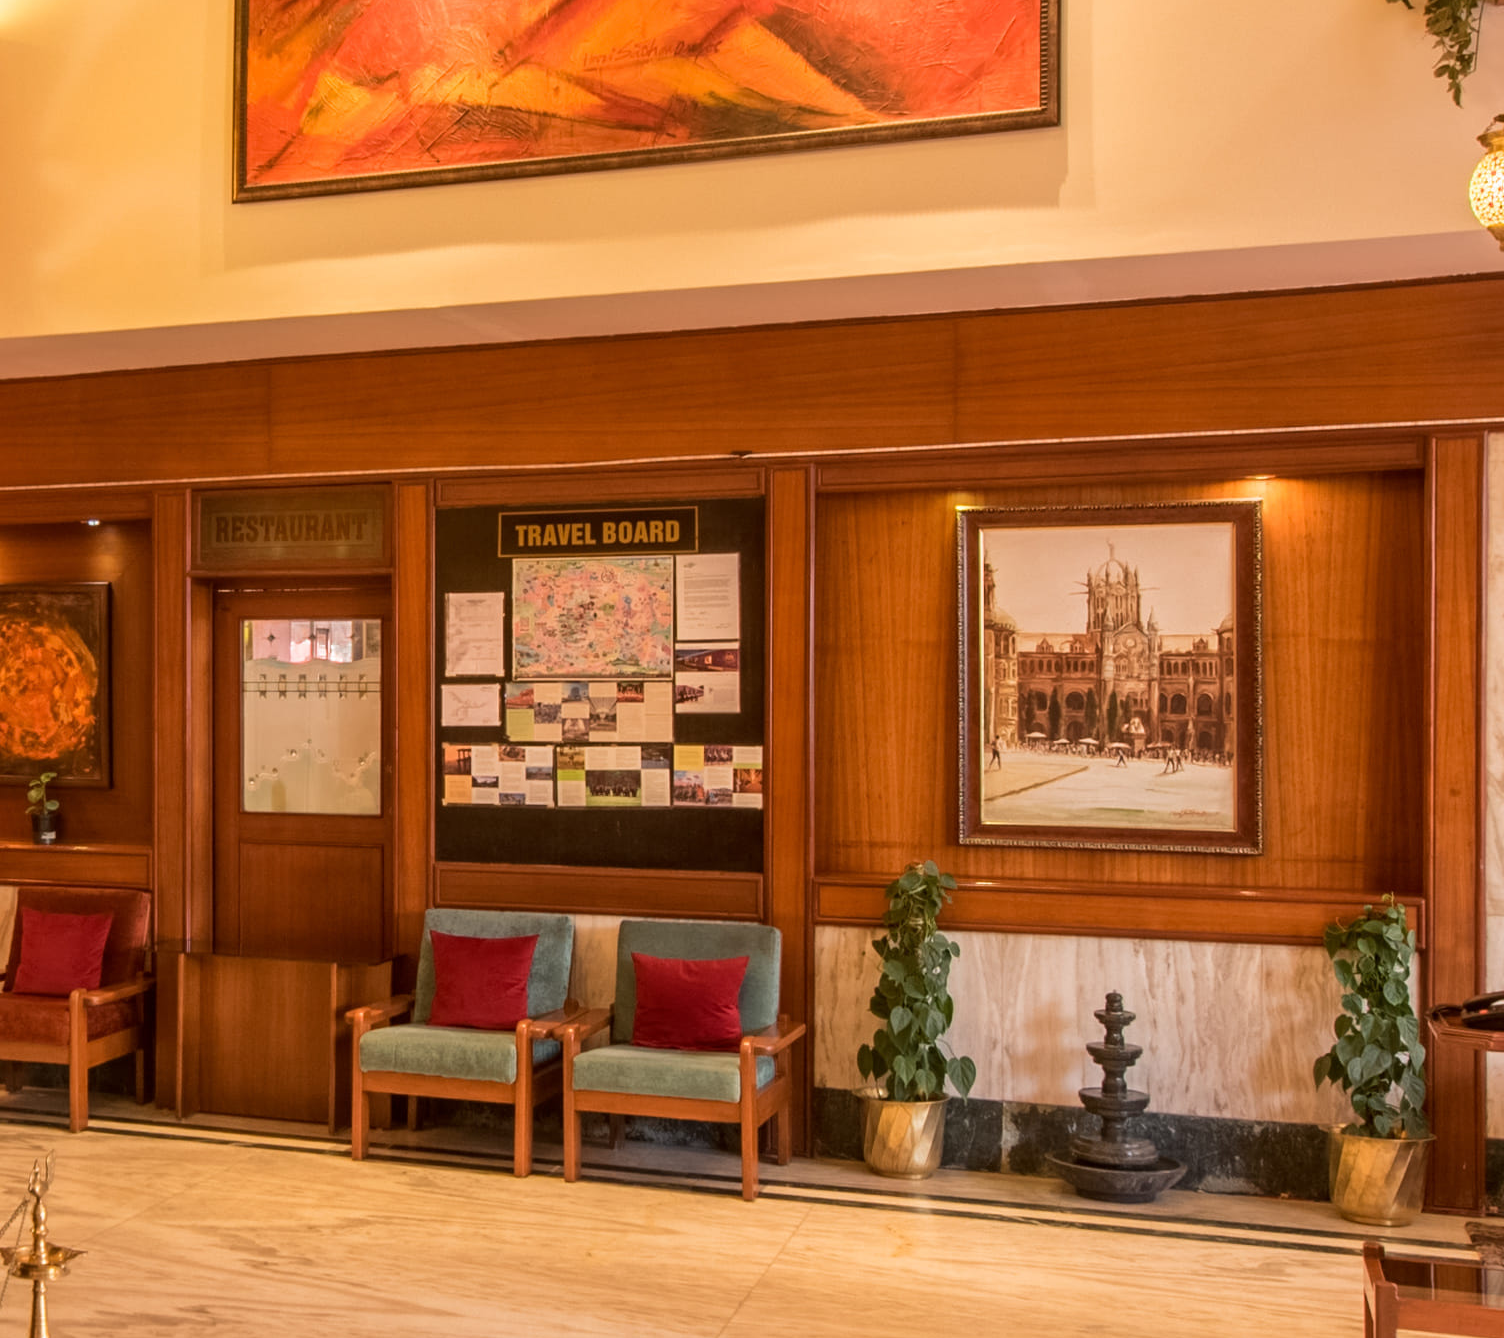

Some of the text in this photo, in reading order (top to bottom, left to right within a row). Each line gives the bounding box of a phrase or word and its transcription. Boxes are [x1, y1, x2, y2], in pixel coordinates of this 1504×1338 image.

[215, 512, 368, 543] RESTAURANT
[515, 520, 681, 547] TRAVEL BOARD
